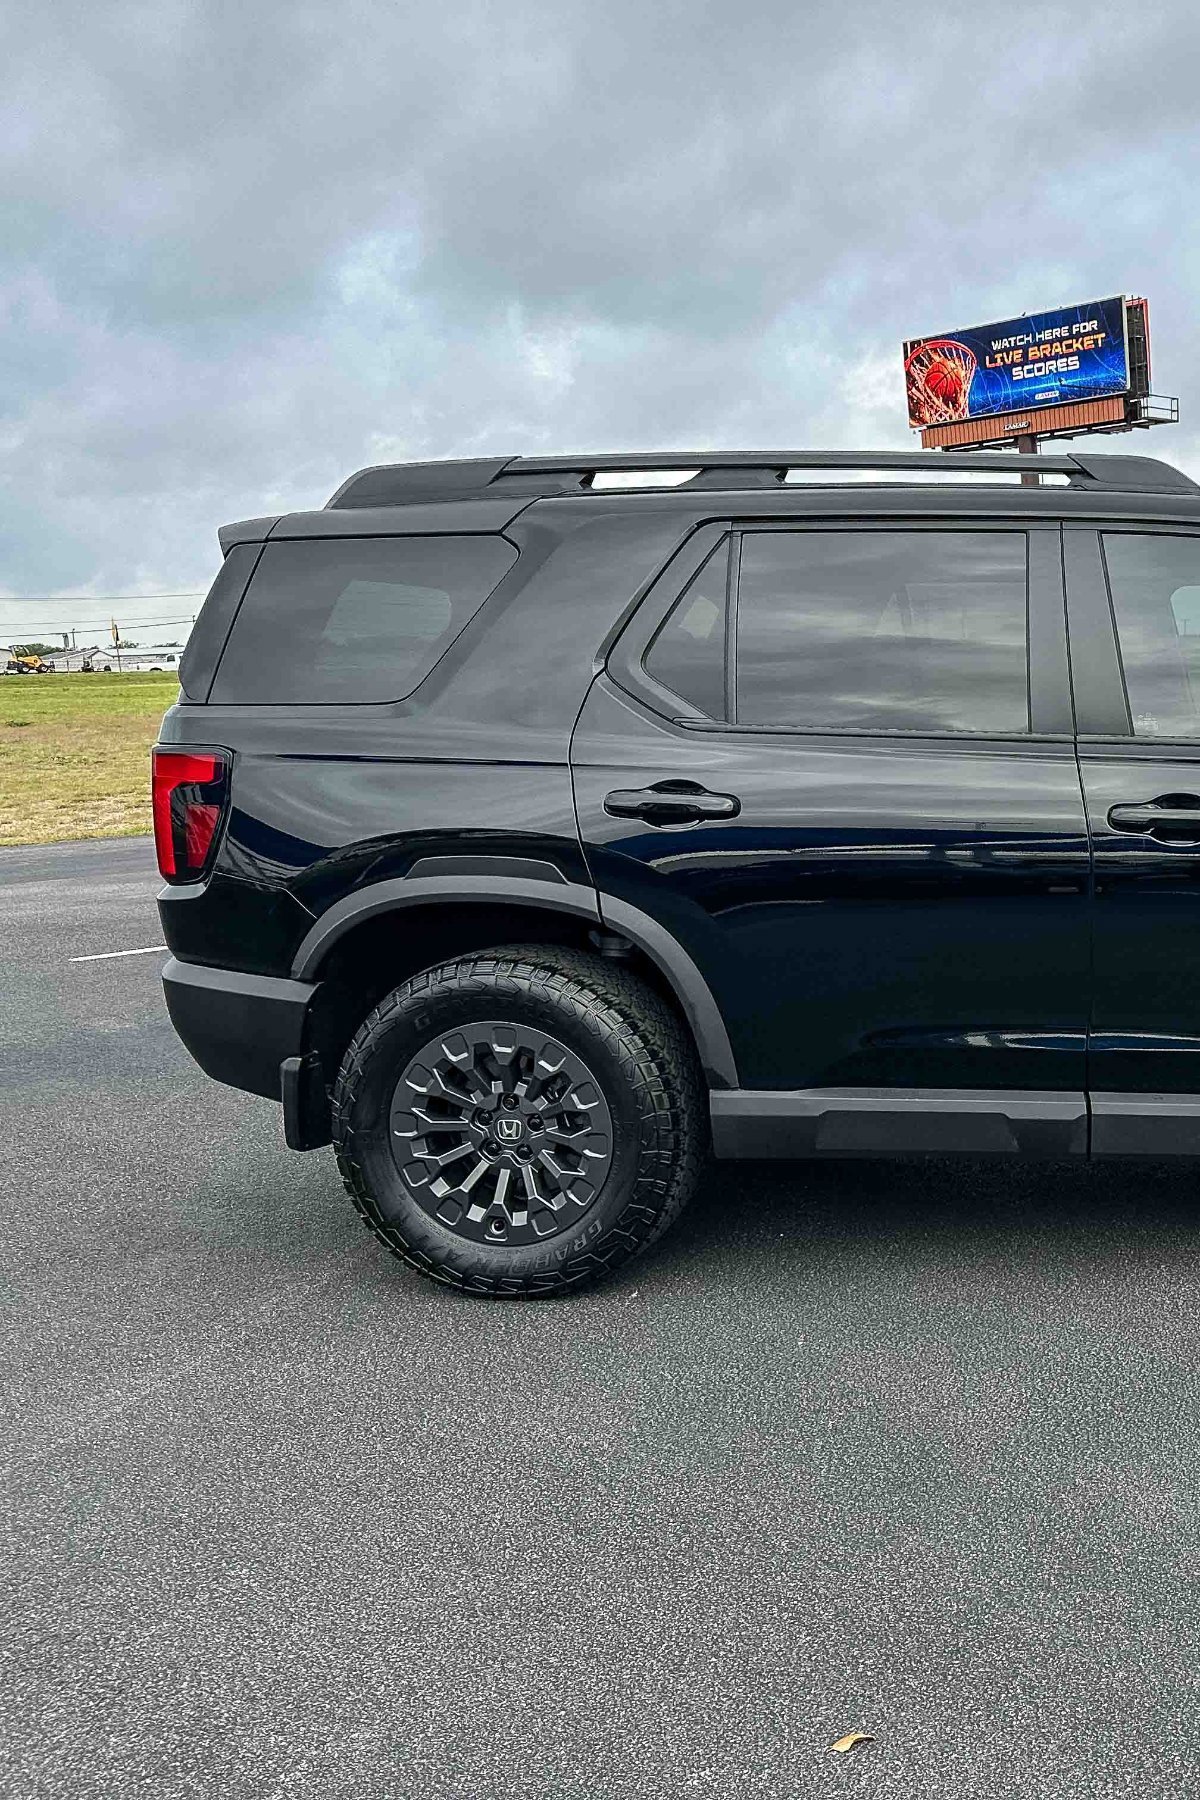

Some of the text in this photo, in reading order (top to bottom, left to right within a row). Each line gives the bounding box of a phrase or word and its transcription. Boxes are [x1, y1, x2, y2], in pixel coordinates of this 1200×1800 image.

[985, 332, 1106, 368] LIVE BRACKET
[991, 319, 1098, 351] WATCH HERE FOR
[1012, 355, 1080, 381] SCORES
